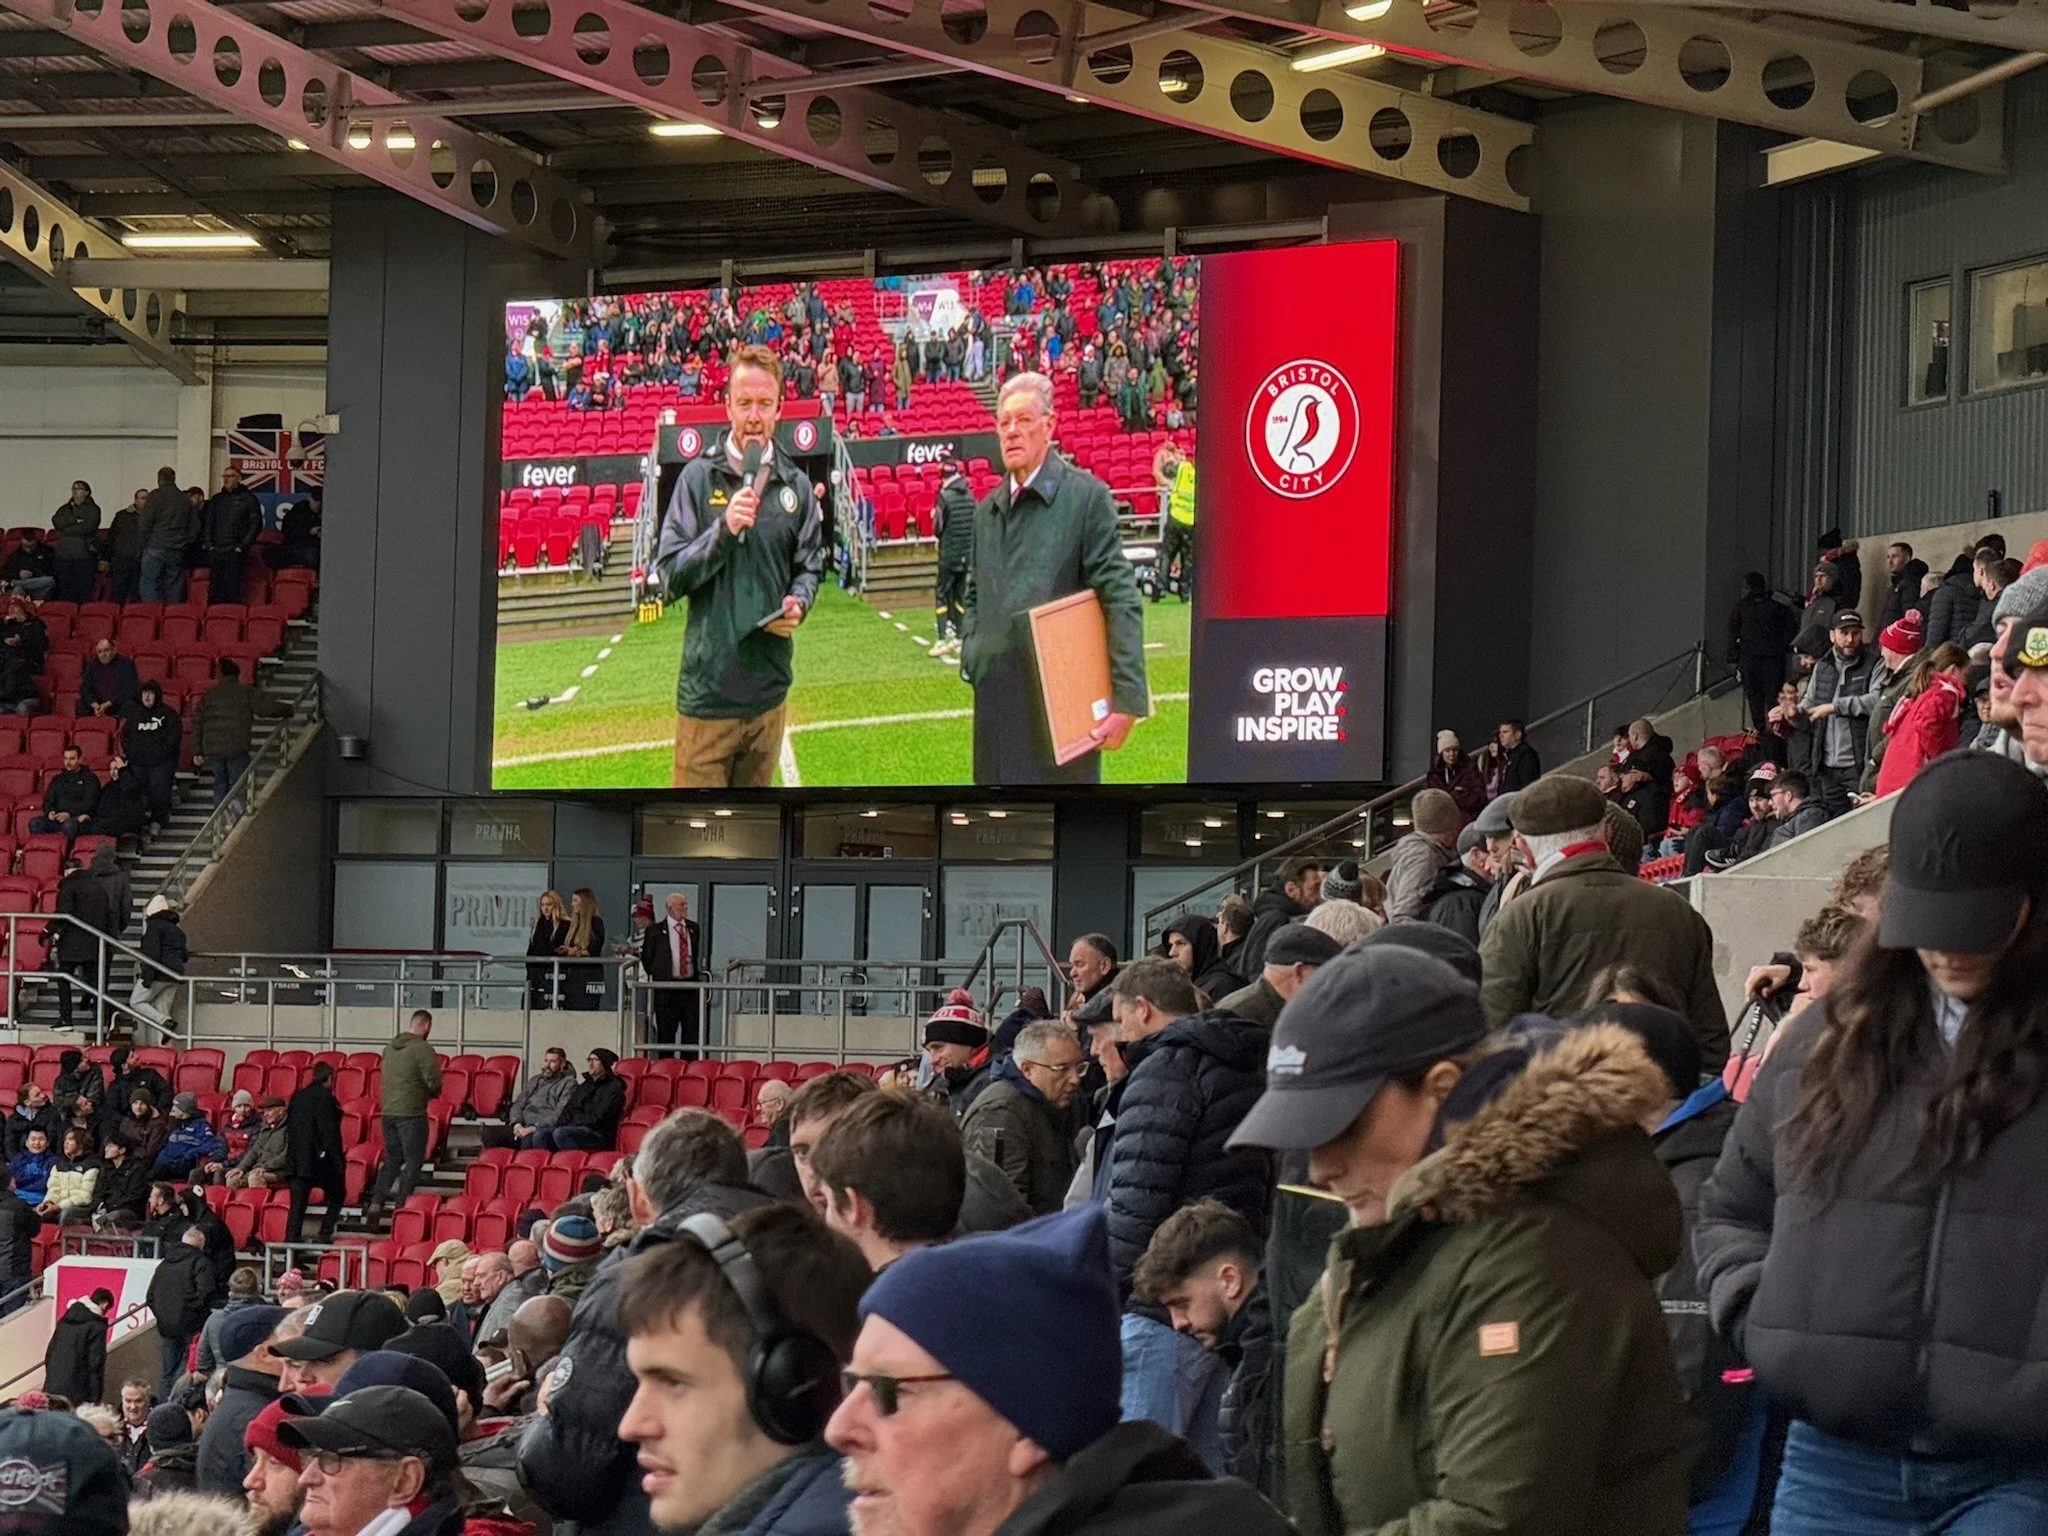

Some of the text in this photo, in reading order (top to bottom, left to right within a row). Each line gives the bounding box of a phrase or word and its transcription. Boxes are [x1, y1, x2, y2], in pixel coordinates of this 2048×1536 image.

[508, 314, 530, 327] W15
[1266, 367, 1341, 397] BRISTOL
[242, 459, 283, 470] BRISTOL
[312, 460, 325, 470] FC
[523, 464, 577, 487] fever
[1279, 471, 1324, 491] CITY
[1252, 667, 1349, 693] GROW.
[1275, 691, 1348, 717] PLAY.
[1236, 715, 1348, 743] INSPIRE.
[475, 824, 521, 841] PRAVHA
